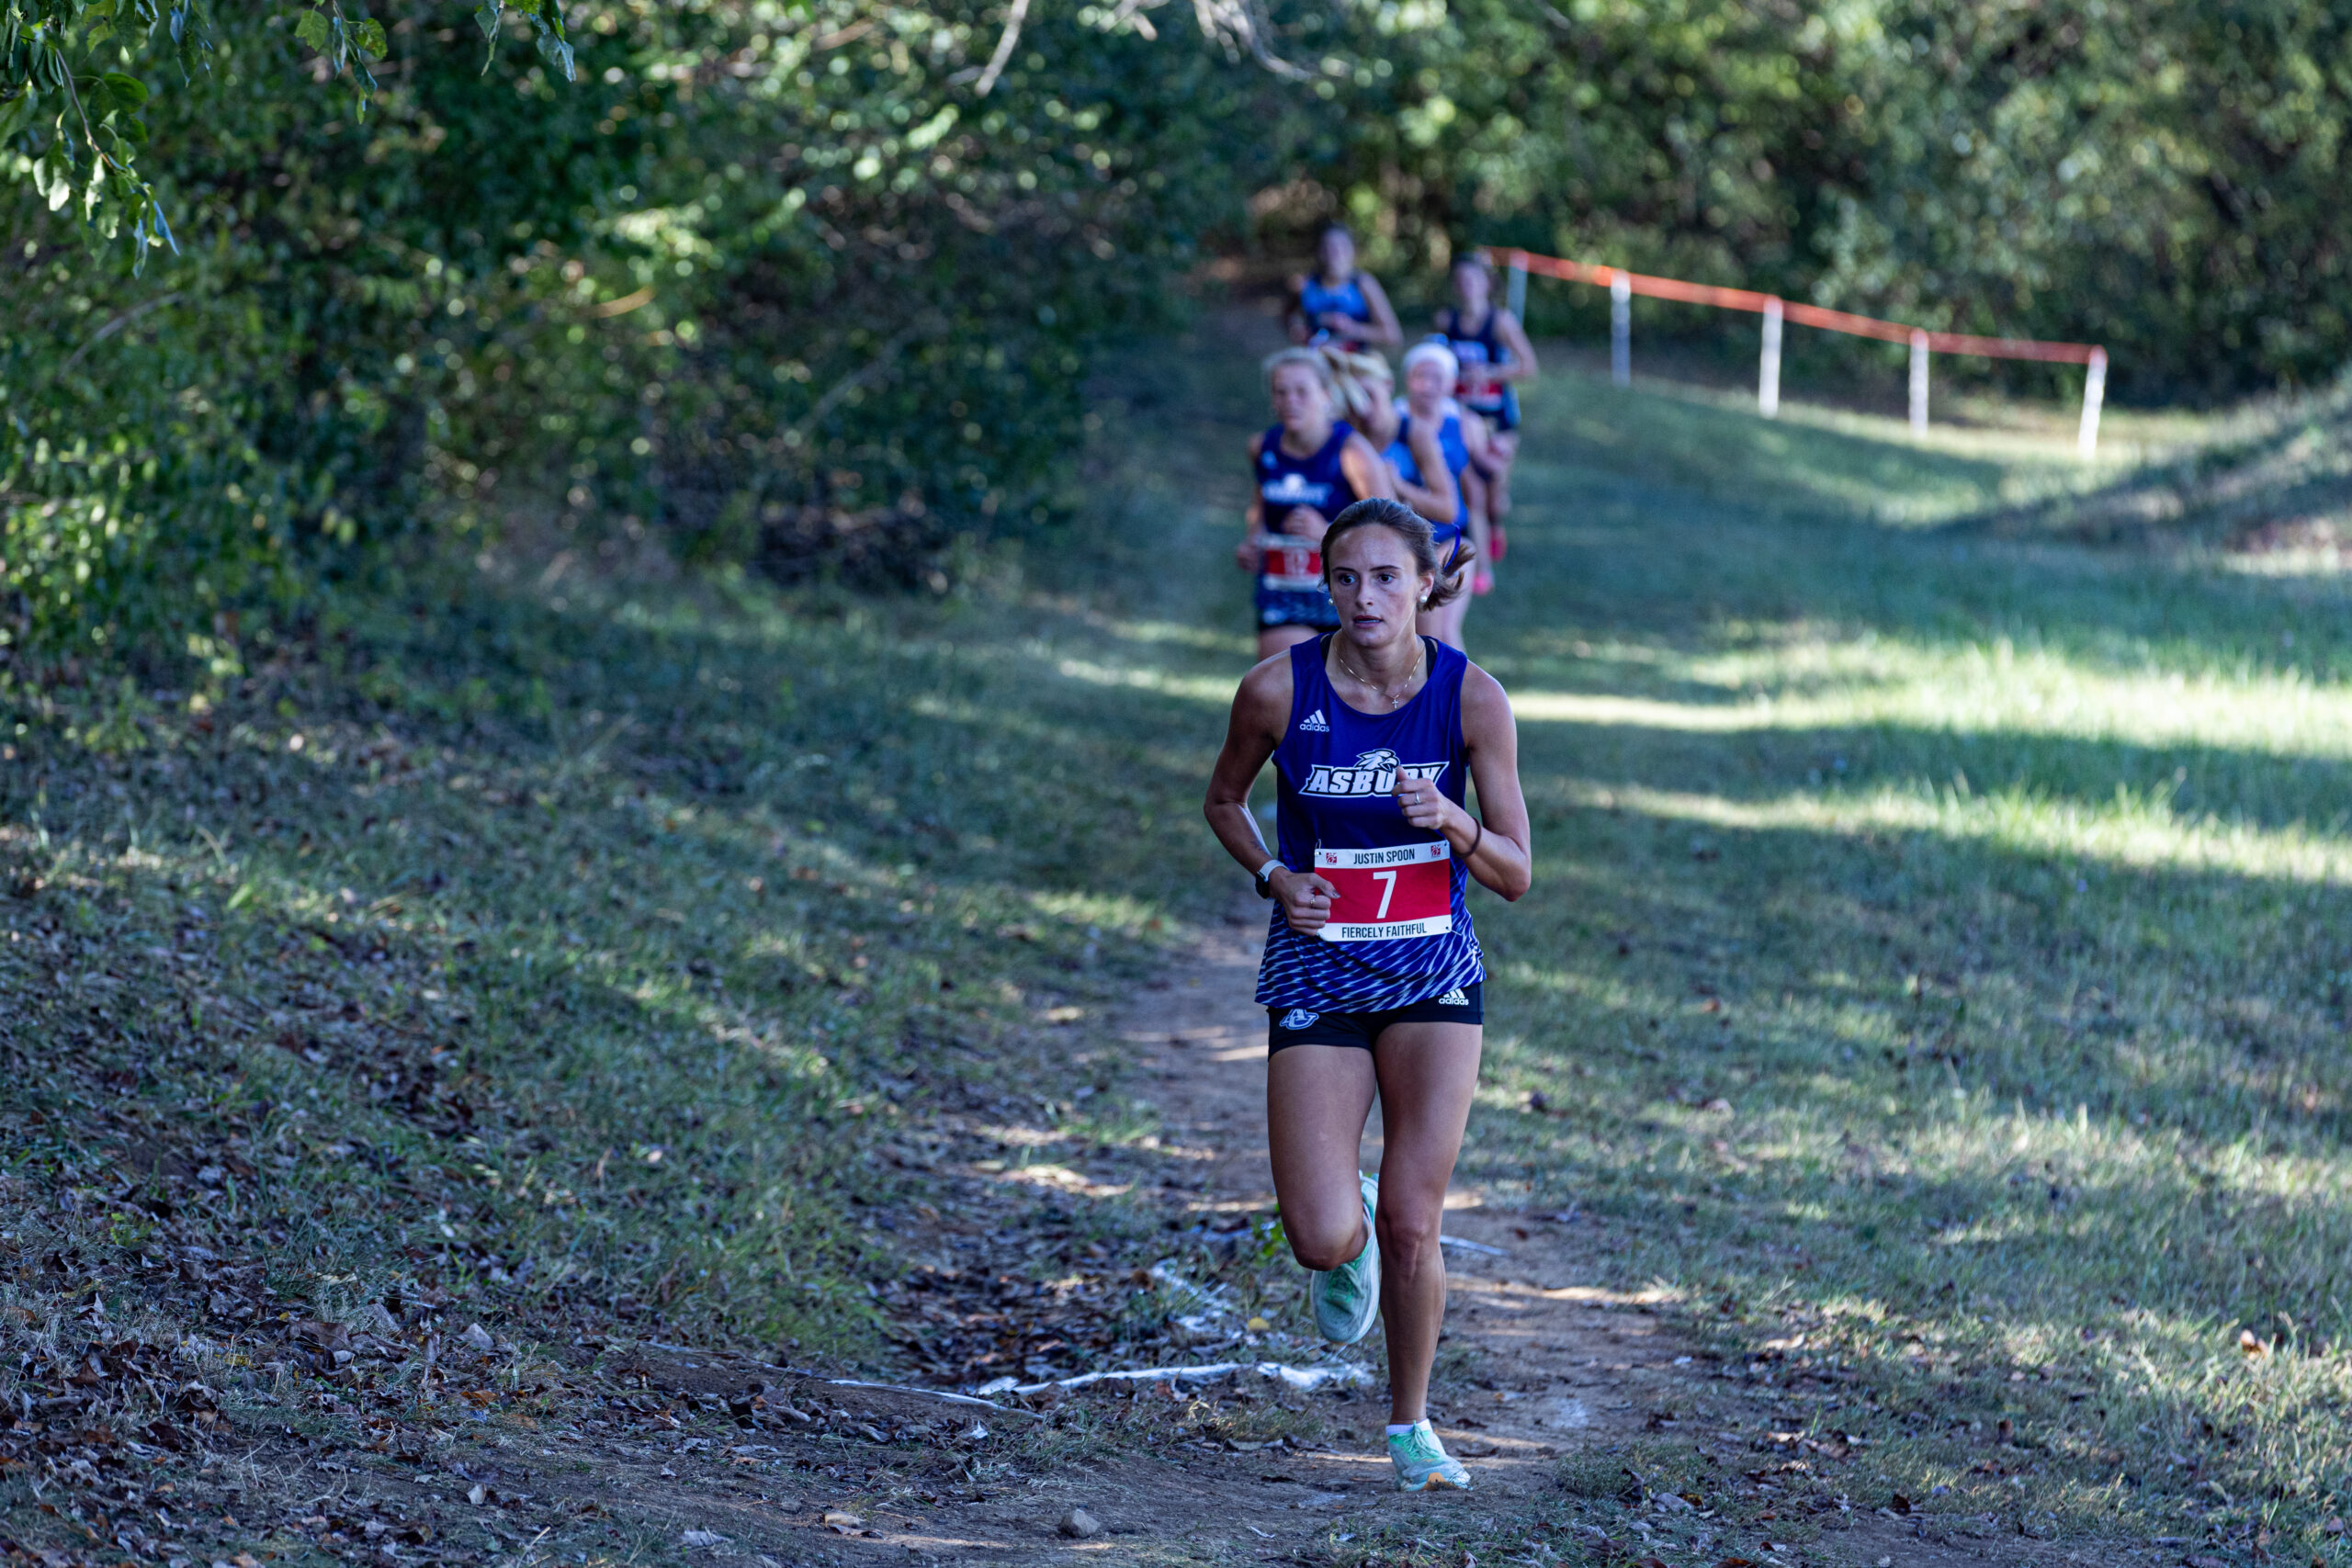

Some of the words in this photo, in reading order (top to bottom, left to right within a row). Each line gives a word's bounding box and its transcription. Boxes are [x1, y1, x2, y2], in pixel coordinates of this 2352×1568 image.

[1299, 723, 1330, 733] adidas
[1353, 852, 1385, 864] JUSTIN
[1386, 849, 1415, 863] SPOON
[1373, 870, 1397, 919] 7
[1341, 926, 1385, 939] FIERCELY
[1385, 922, 1428, 937] FAITHFUL
[1438, 998, 1469, 1006] adidas
